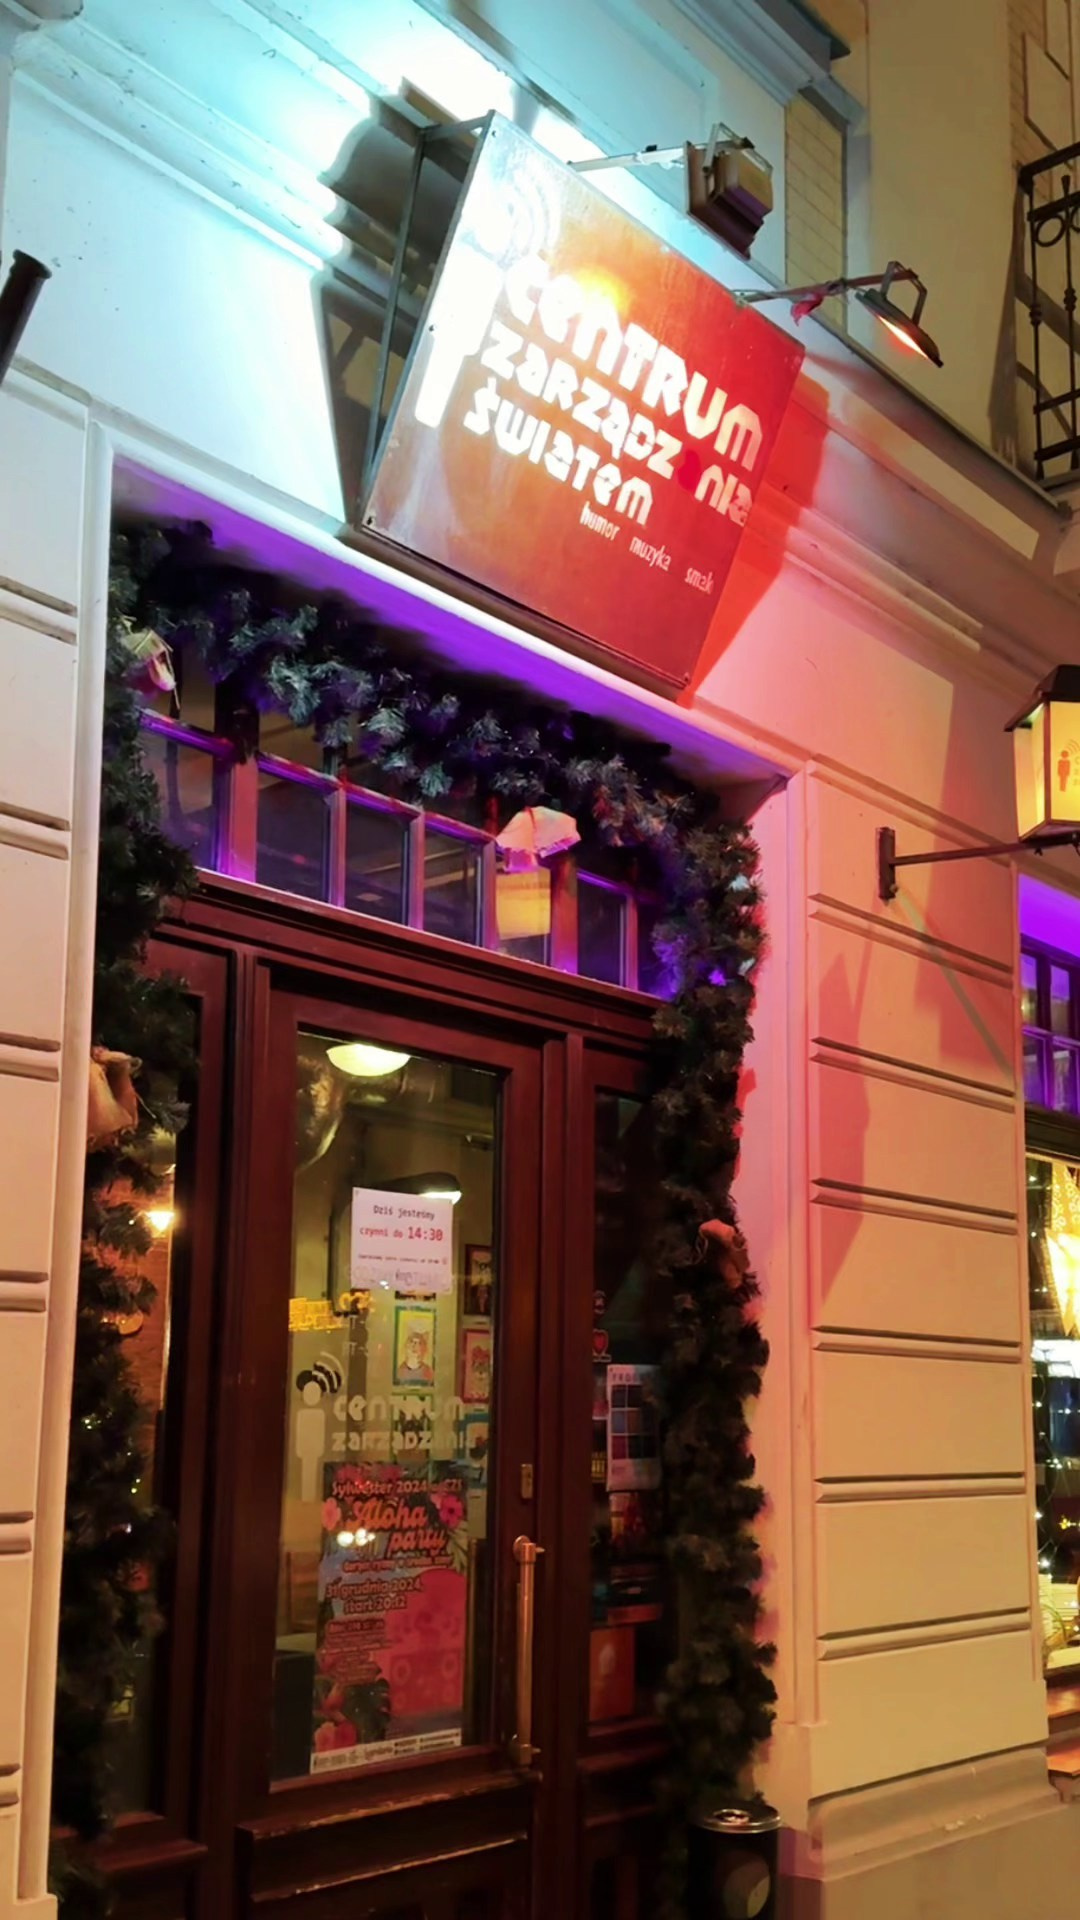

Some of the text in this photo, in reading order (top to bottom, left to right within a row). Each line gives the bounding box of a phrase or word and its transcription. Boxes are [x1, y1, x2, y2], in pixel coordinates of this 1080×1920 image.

[580, 501, 714, 594] humor muzyka smak
[373, 1204, 435, 1221] Dziś jesteśmy
[359, 1226, 444, 1241] czynni do 14:30
[332, 1480, 393, 1498] Sylwester
[396, 1480, 427, 1494] 2024
[345, 1498, 427, 1532] Aloha
[386, 1530, 446, 1558] party
[340, 1577, 391, 1598] grudnia
[393, 1577, 422, 1592] 2024
[344, 1600, 373, 1614] start
